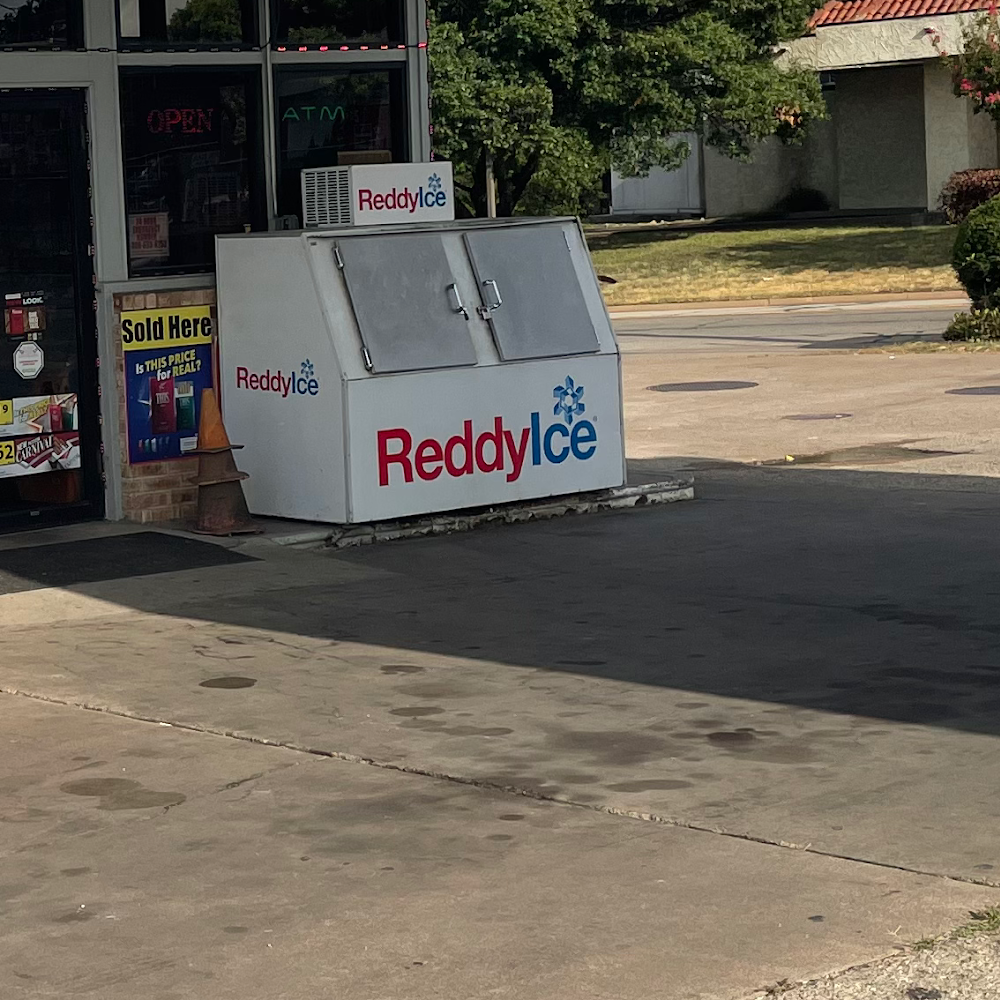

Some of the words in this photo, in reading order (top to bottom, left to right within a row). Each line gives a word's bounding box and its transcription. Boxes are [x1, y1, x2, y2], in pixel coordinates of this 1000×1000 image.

[147, 109, 213, 133] OPEN
[282, 106, 345, 121] ATM
[358, 186, 446, 213] ReddyIce
[122, 316, 164, 343] Sold
[168, 315, 211, 339] Here
[135, 363, 145, 375] Is
[144, 356, 168, 372] THIS
[168, 349, 196, 366] PRICE
[157, 369, 171, 381] for
[172, 360, 202, 377] REAL?
[237, 367, 319, 398] ReddyIce
[377, 411, 597, 486] ReddyIce
